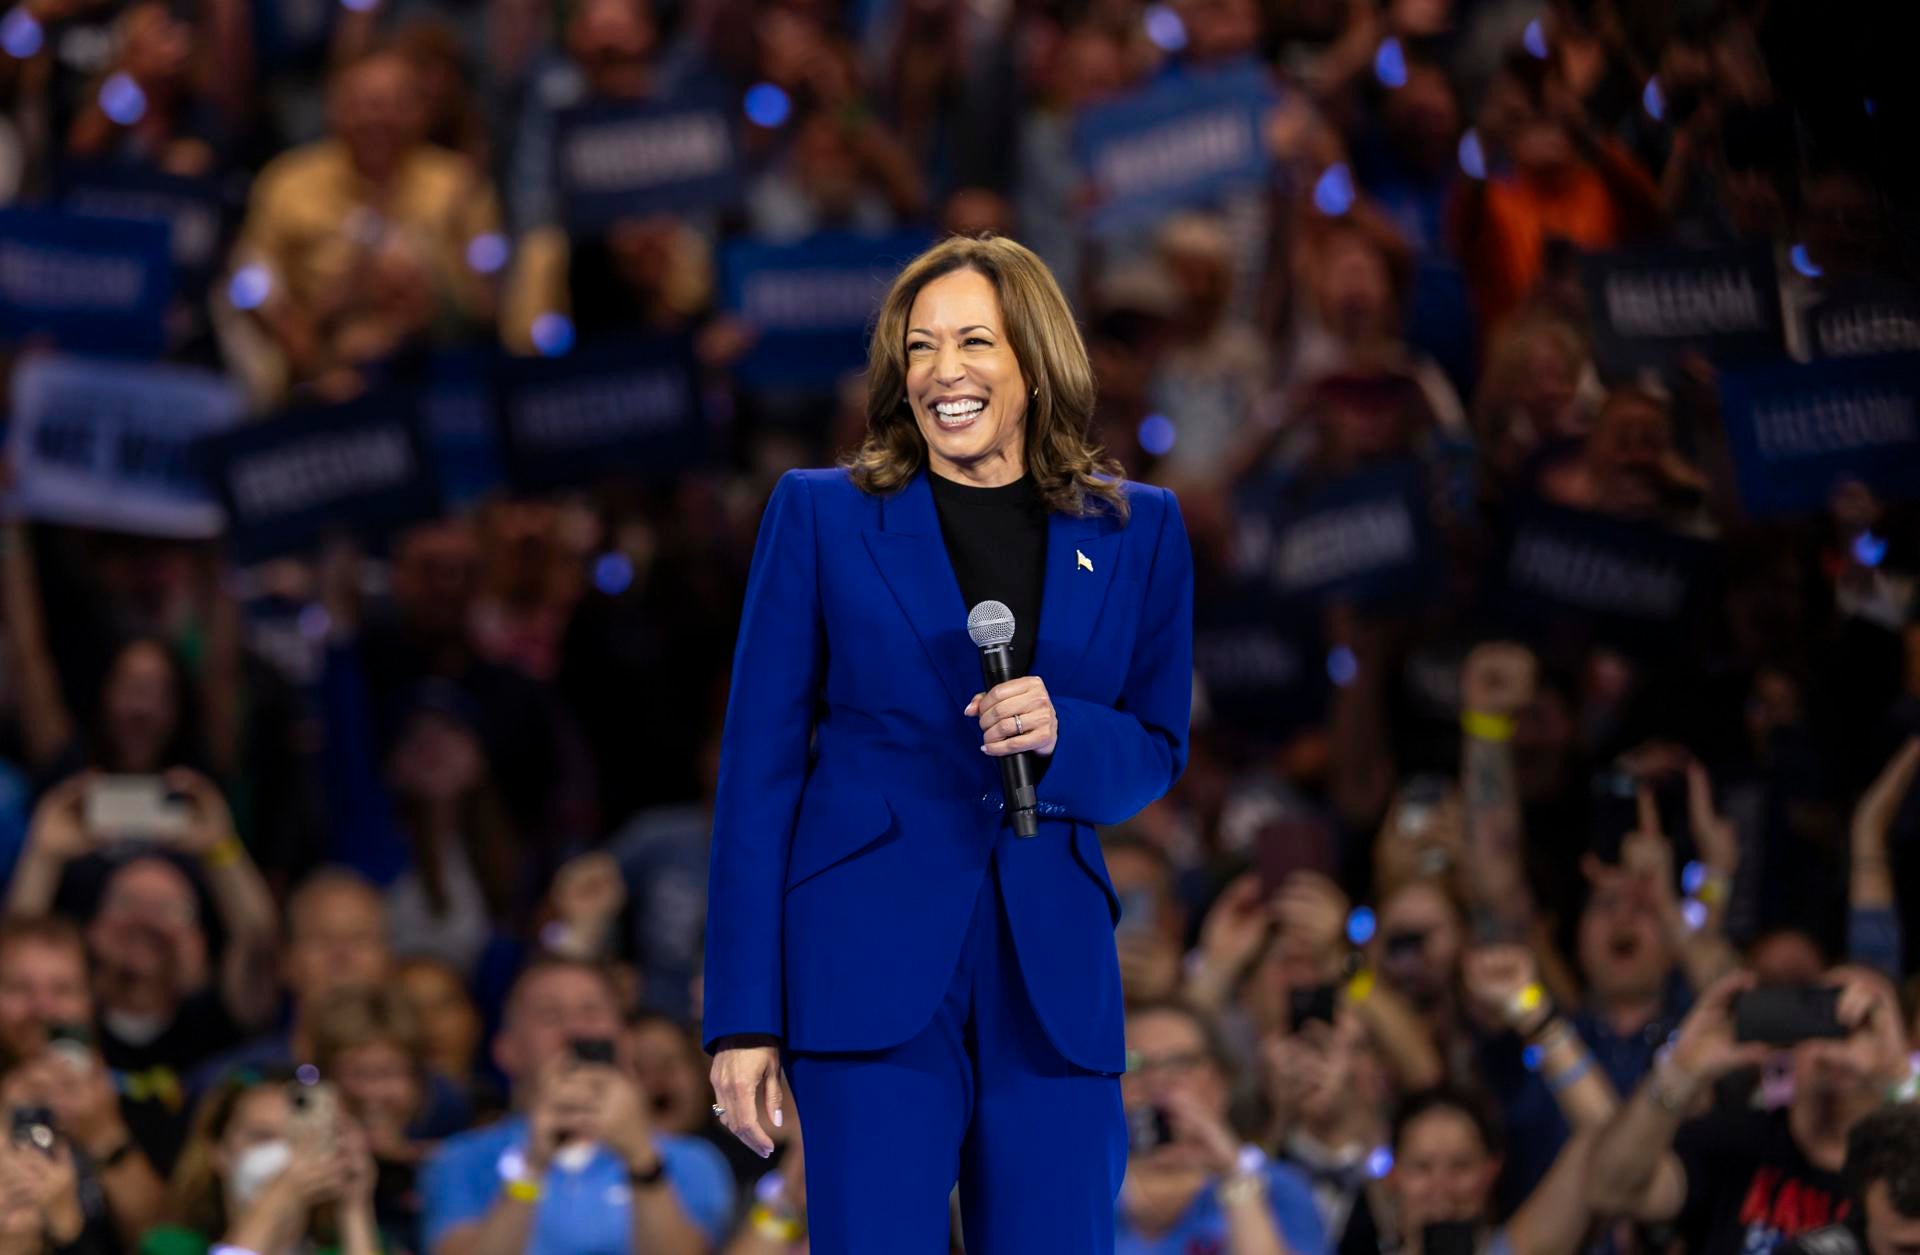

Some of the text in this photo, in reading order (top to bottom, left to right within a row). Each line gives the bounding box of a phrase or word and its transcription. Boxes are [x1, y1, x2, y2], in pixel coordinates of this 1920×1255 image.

[1604, 268, 1764, 337] FREEDOM
[1752, 385, 1917, 463] FREEDOM
[1509, 526, 1687, 620] FREEDOM
